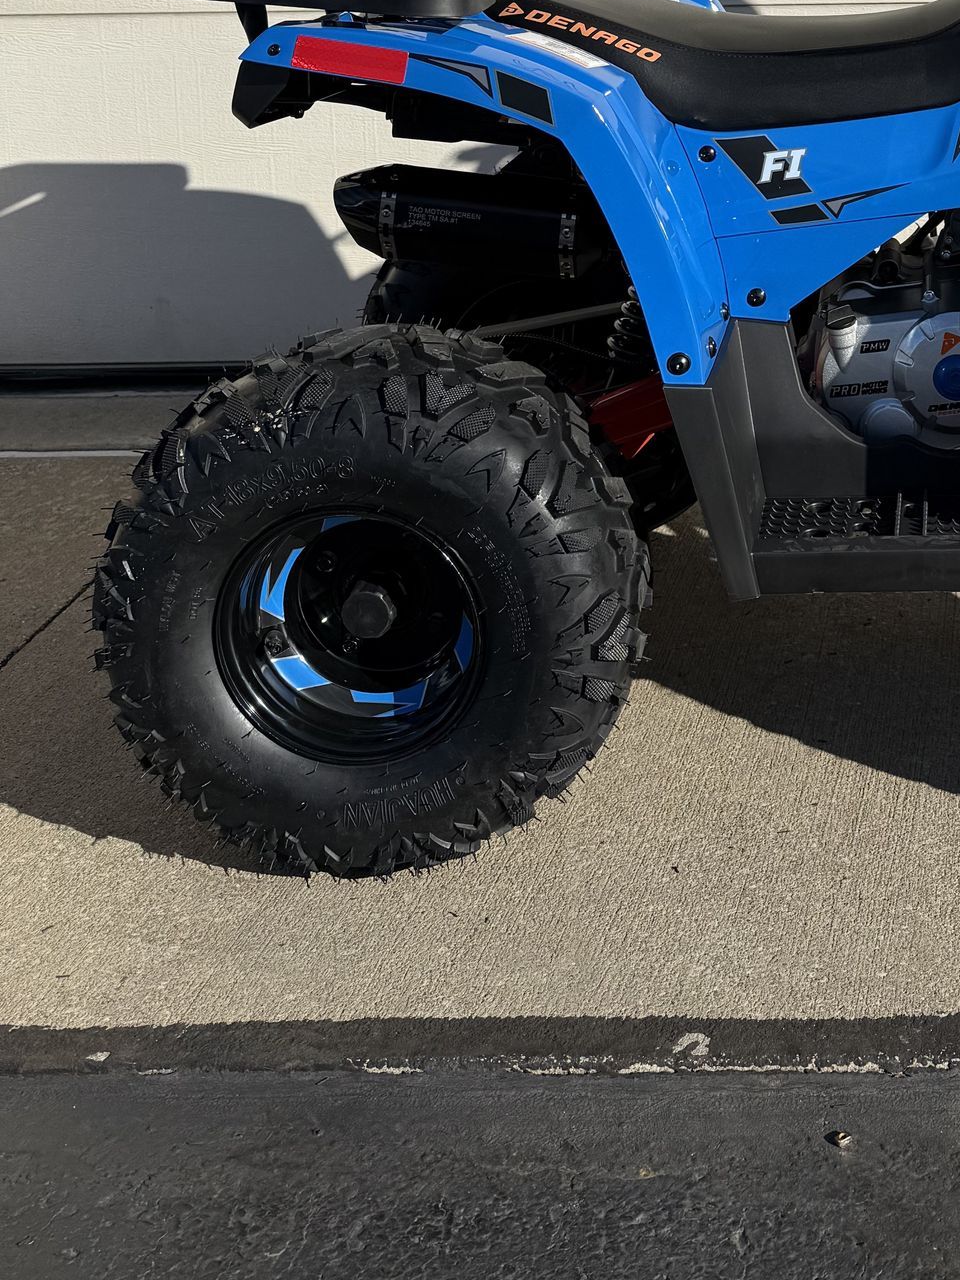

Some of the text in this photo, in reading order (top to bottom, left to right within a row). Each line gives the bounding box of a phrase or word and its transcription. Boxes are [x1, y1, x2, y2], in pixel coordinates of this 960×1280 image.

[524, 7, 662, 63] DENAGO
[756, 148, 806, 184] FI
[408, 206, 481, 221] TAO MOTOR SCREEN
[408, 212, 427, 220] TYPE
[861, 340, 889, 353] PMW
[831, 384, 859, 398] PRO
[342, 776, 456, 828] HUAJIAN
